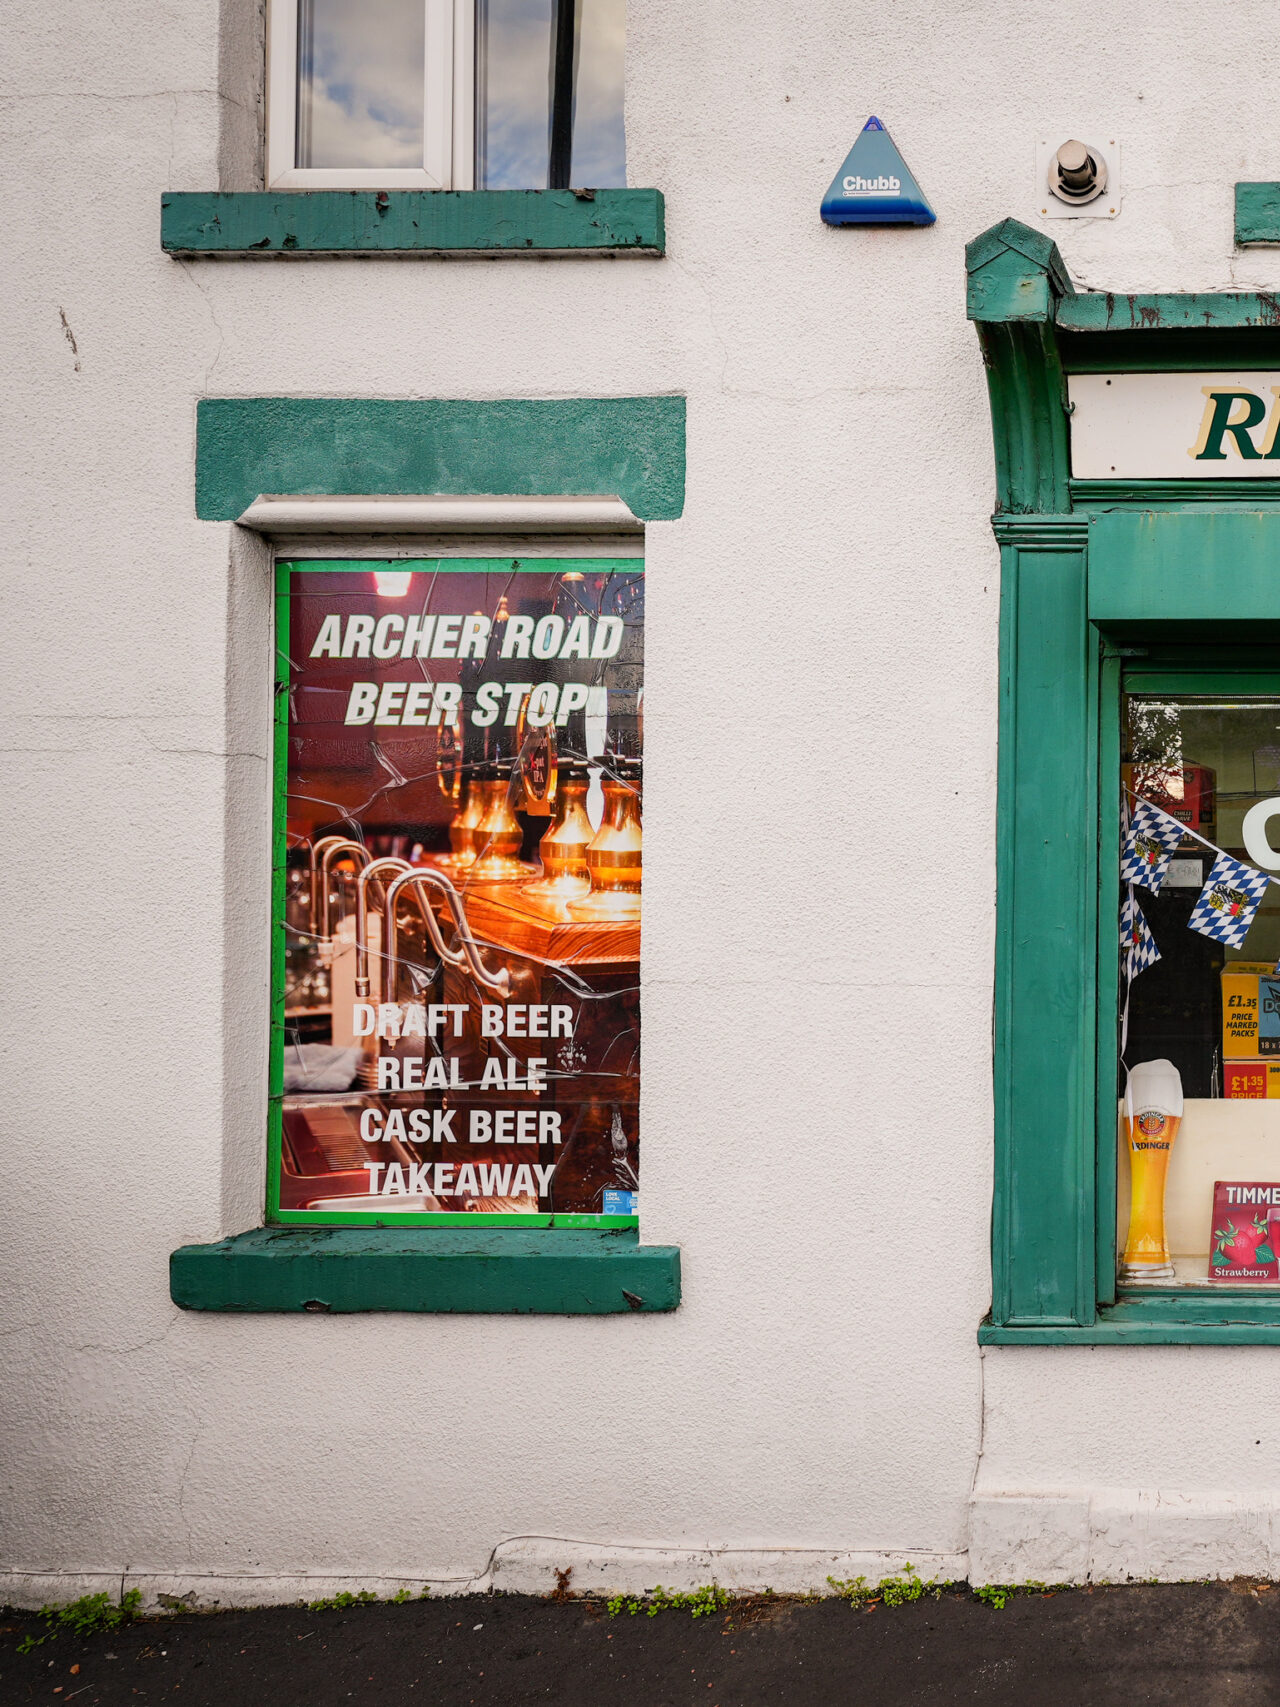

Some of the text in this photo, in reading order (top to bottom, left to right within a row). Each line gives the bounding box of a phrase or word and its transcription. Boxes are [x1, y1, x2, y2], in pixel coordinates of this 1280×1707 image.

[842, 176, 901, 190] Chubb
[310, 614, 624, 660] ARCHER ROAD
[345, 682, 463, 727] BEER
[1228, 995, 1257, 1008] £1.35
[352, 1003, 574, 1038] DRAFT BEER
[1231, 1013, 1253, 1021] PRICE
[1226, 1021, 1258, 1029] MARKED
[1231, 1029, 1255, 1037] PACKS
[377, 1056, 548, 1091] REAL ALE
[1231, 1076, 1264, 1091] £1.35
[360, 1109, 563, 1144] CASK BEER
[363, 1162, 557, 1198] TAKEAWAY
[1214, 1267, 1270, 1279] Strawberry
